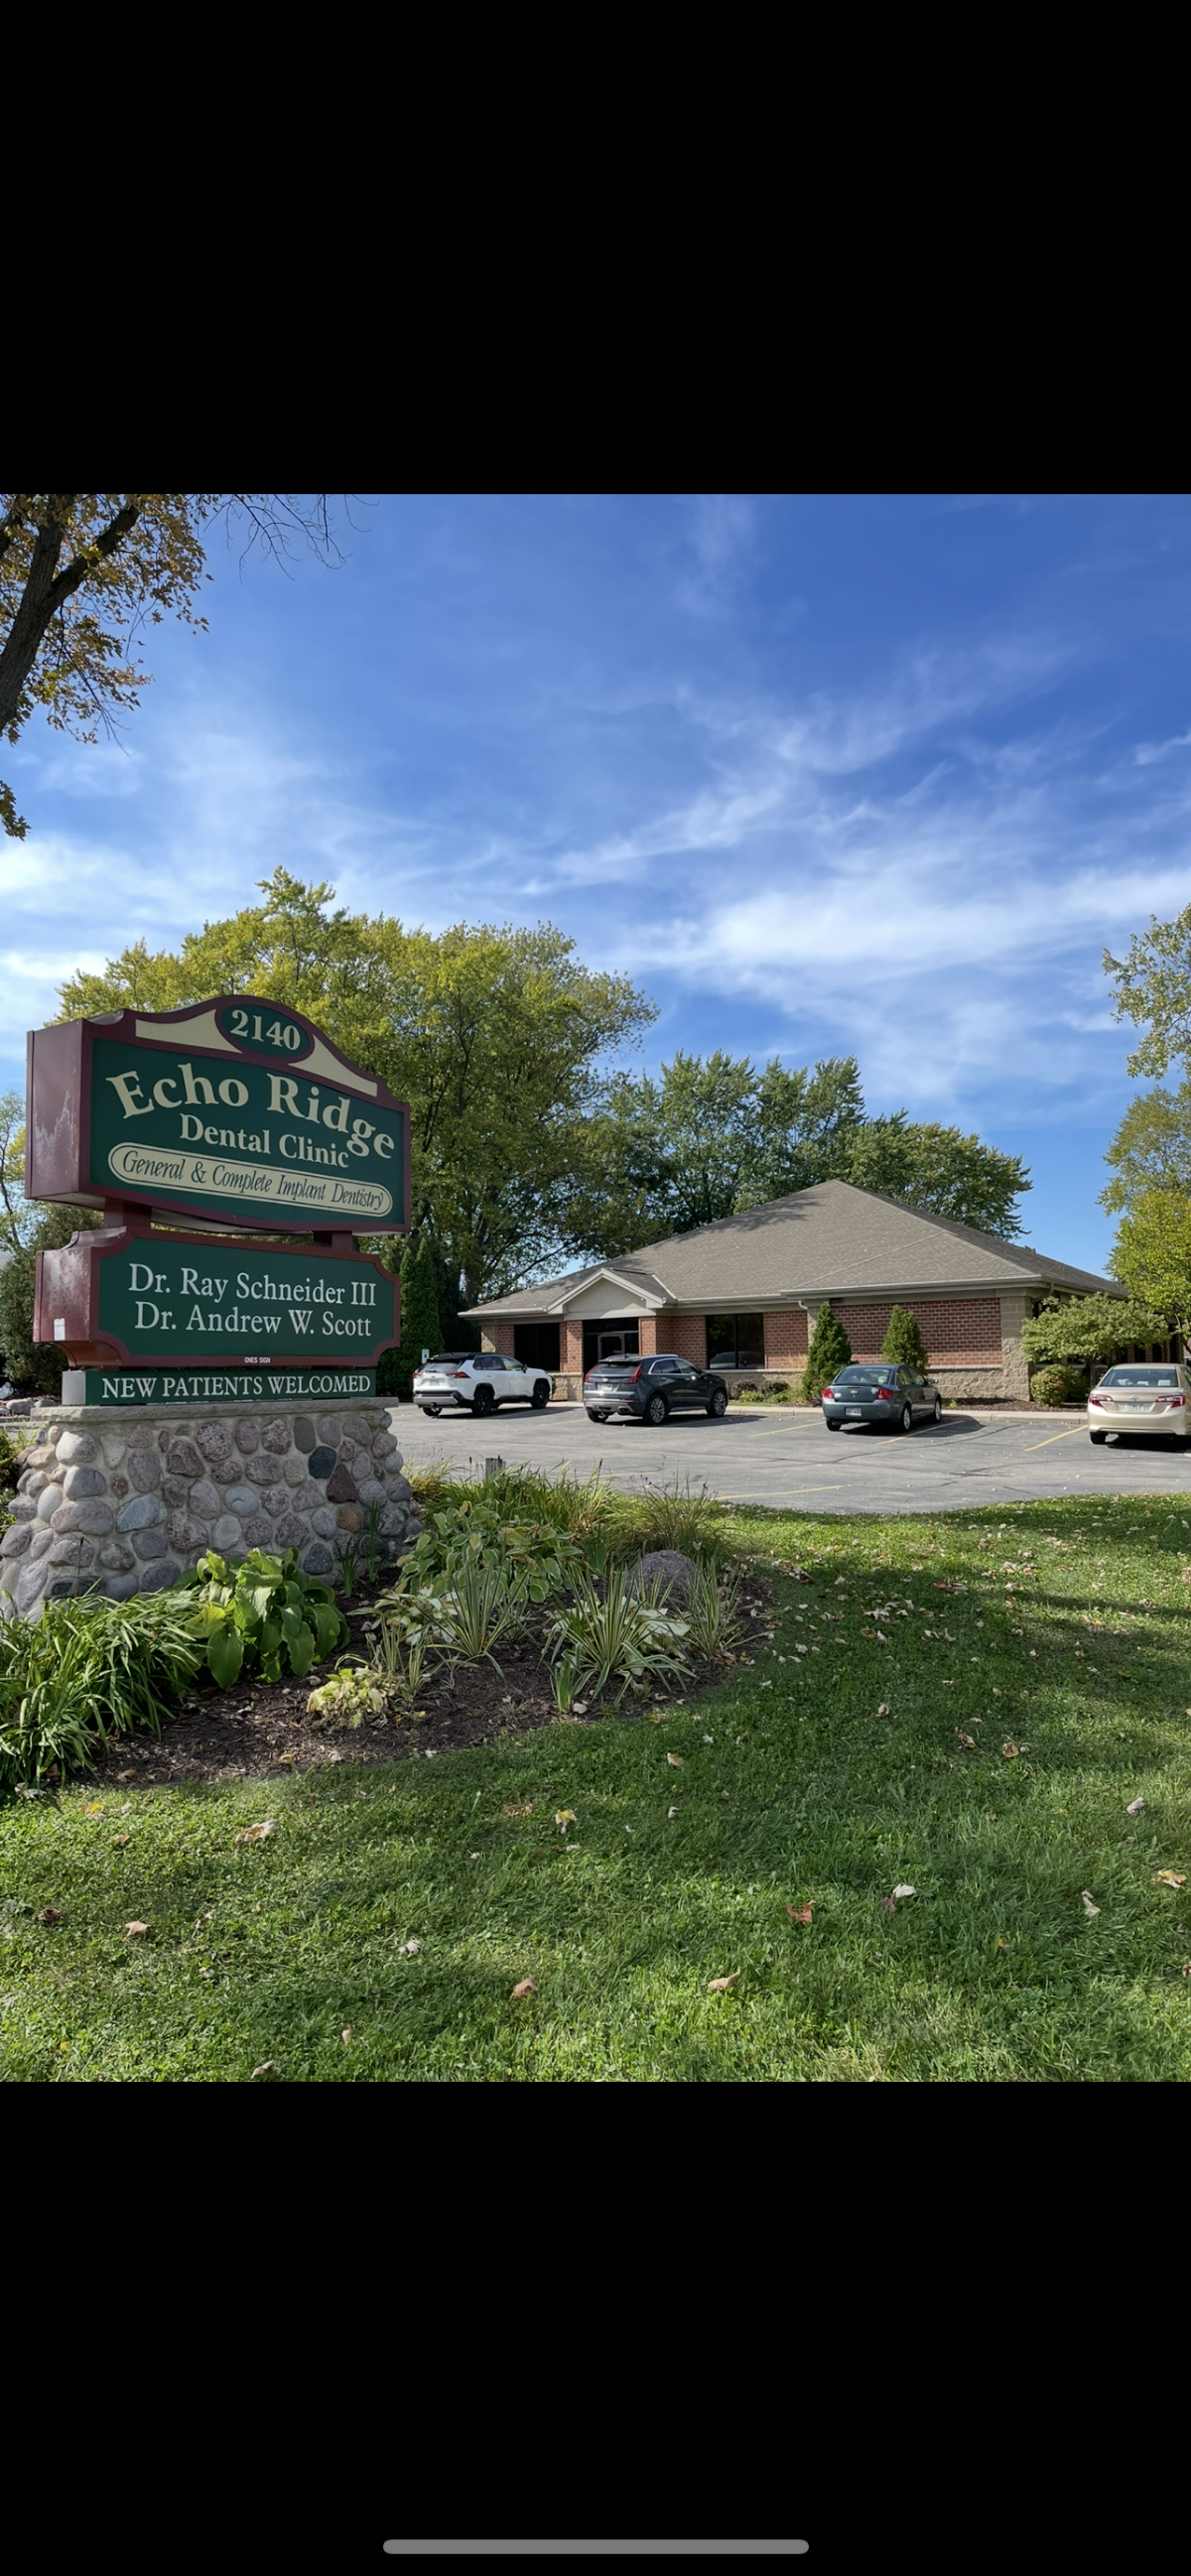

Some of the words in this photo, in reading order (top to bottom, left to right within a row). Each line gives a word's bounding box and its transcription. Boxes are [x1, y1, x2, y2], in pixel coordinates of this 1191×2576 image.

[230, 1009, 301, 1051] 2140
[105, 1063, 249, 1119] Echo
[266, 1073, 395, 1159] Ridge
[179, 1112, 272, 1154] Dental
[279, 1134, 349, 1168] Clinic
[122, 1150, 186, 1180] General
[191, 1161, 206, 1184] &
[212, 1165, 273, 1193] Complete
[276, 1178, 326, 1201] Implant
[331, 1183, 384, 1210] Dentistry
[128, 1262, 171, 1293] Dr.
[180, 1267, 228, 1304] Ray
[235, 1272, 345, 1304] Schneider
[350, 1281, 377, 1306] III
[134, 1301, 177, 1330] Dr.
[186, 1304, 282, 1334] Andrew
[288, 1309, 315, 1335] W.
[322, 1311, 371, 1337] Scott
[101, 1377, 157, 1399] NEW
[162, 1376, 263, 1397] PATIENTS
[267, 1375, 371, 1395] WELCOMED
